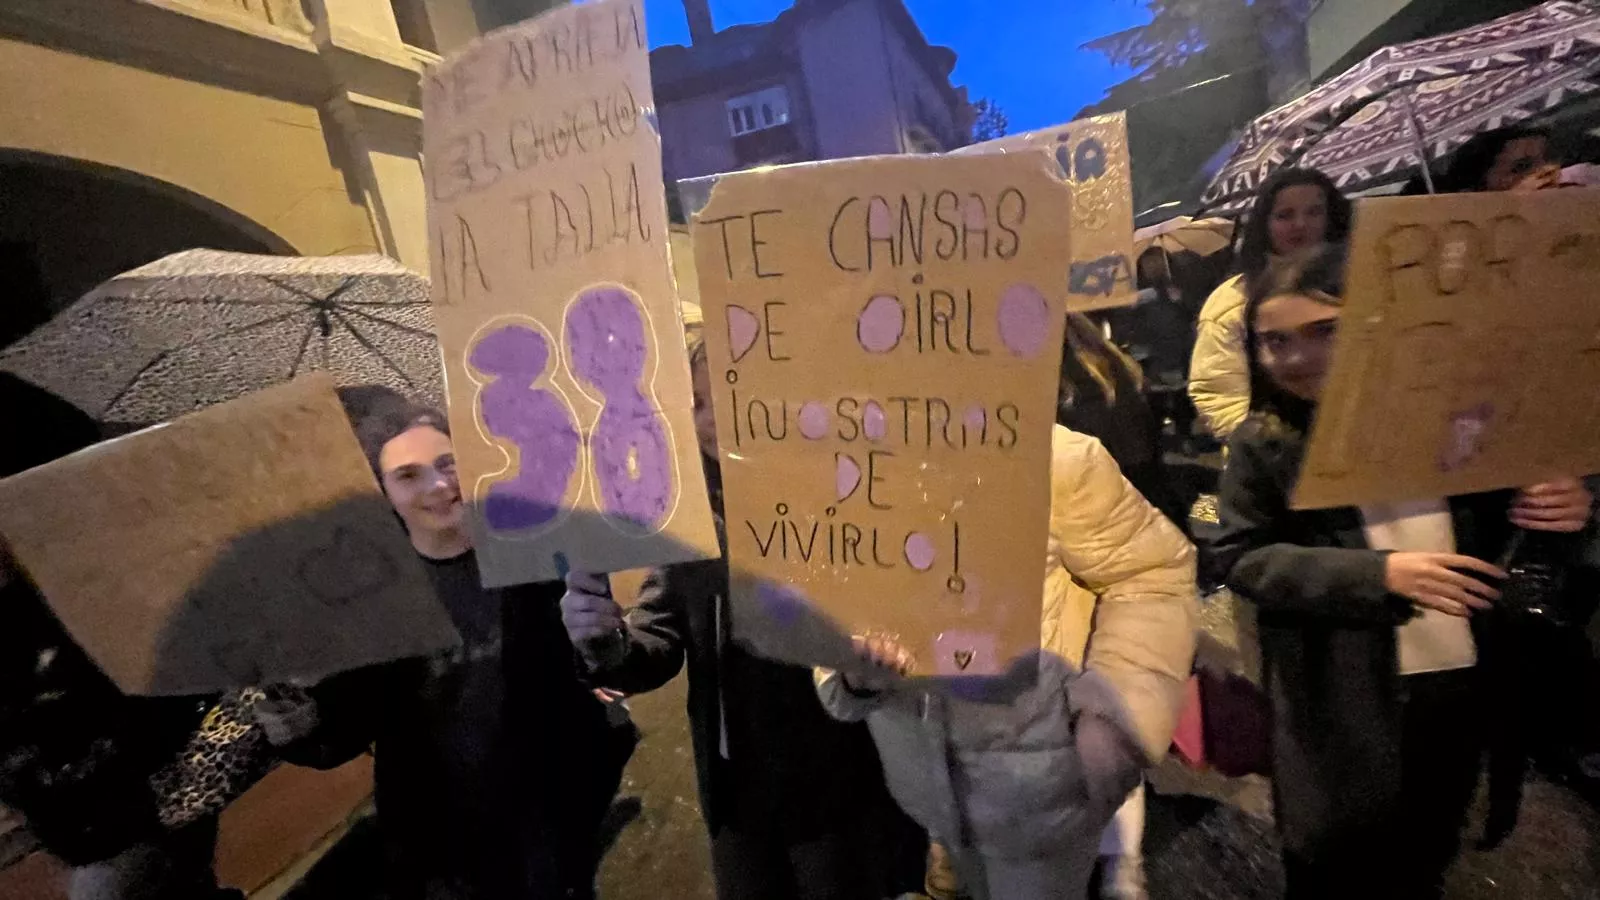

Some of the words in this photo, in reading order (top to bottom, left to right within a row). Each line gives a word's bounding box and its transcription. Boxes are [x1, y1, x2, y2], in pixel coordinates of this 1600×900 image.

[699, 209, 784, 281] TE
[828, 187, 1028, 273] CANSAS
[726, 302, 793, 364] DE
[465, 282, 681, 540] 38
[834, 450, 897, 509] DE
